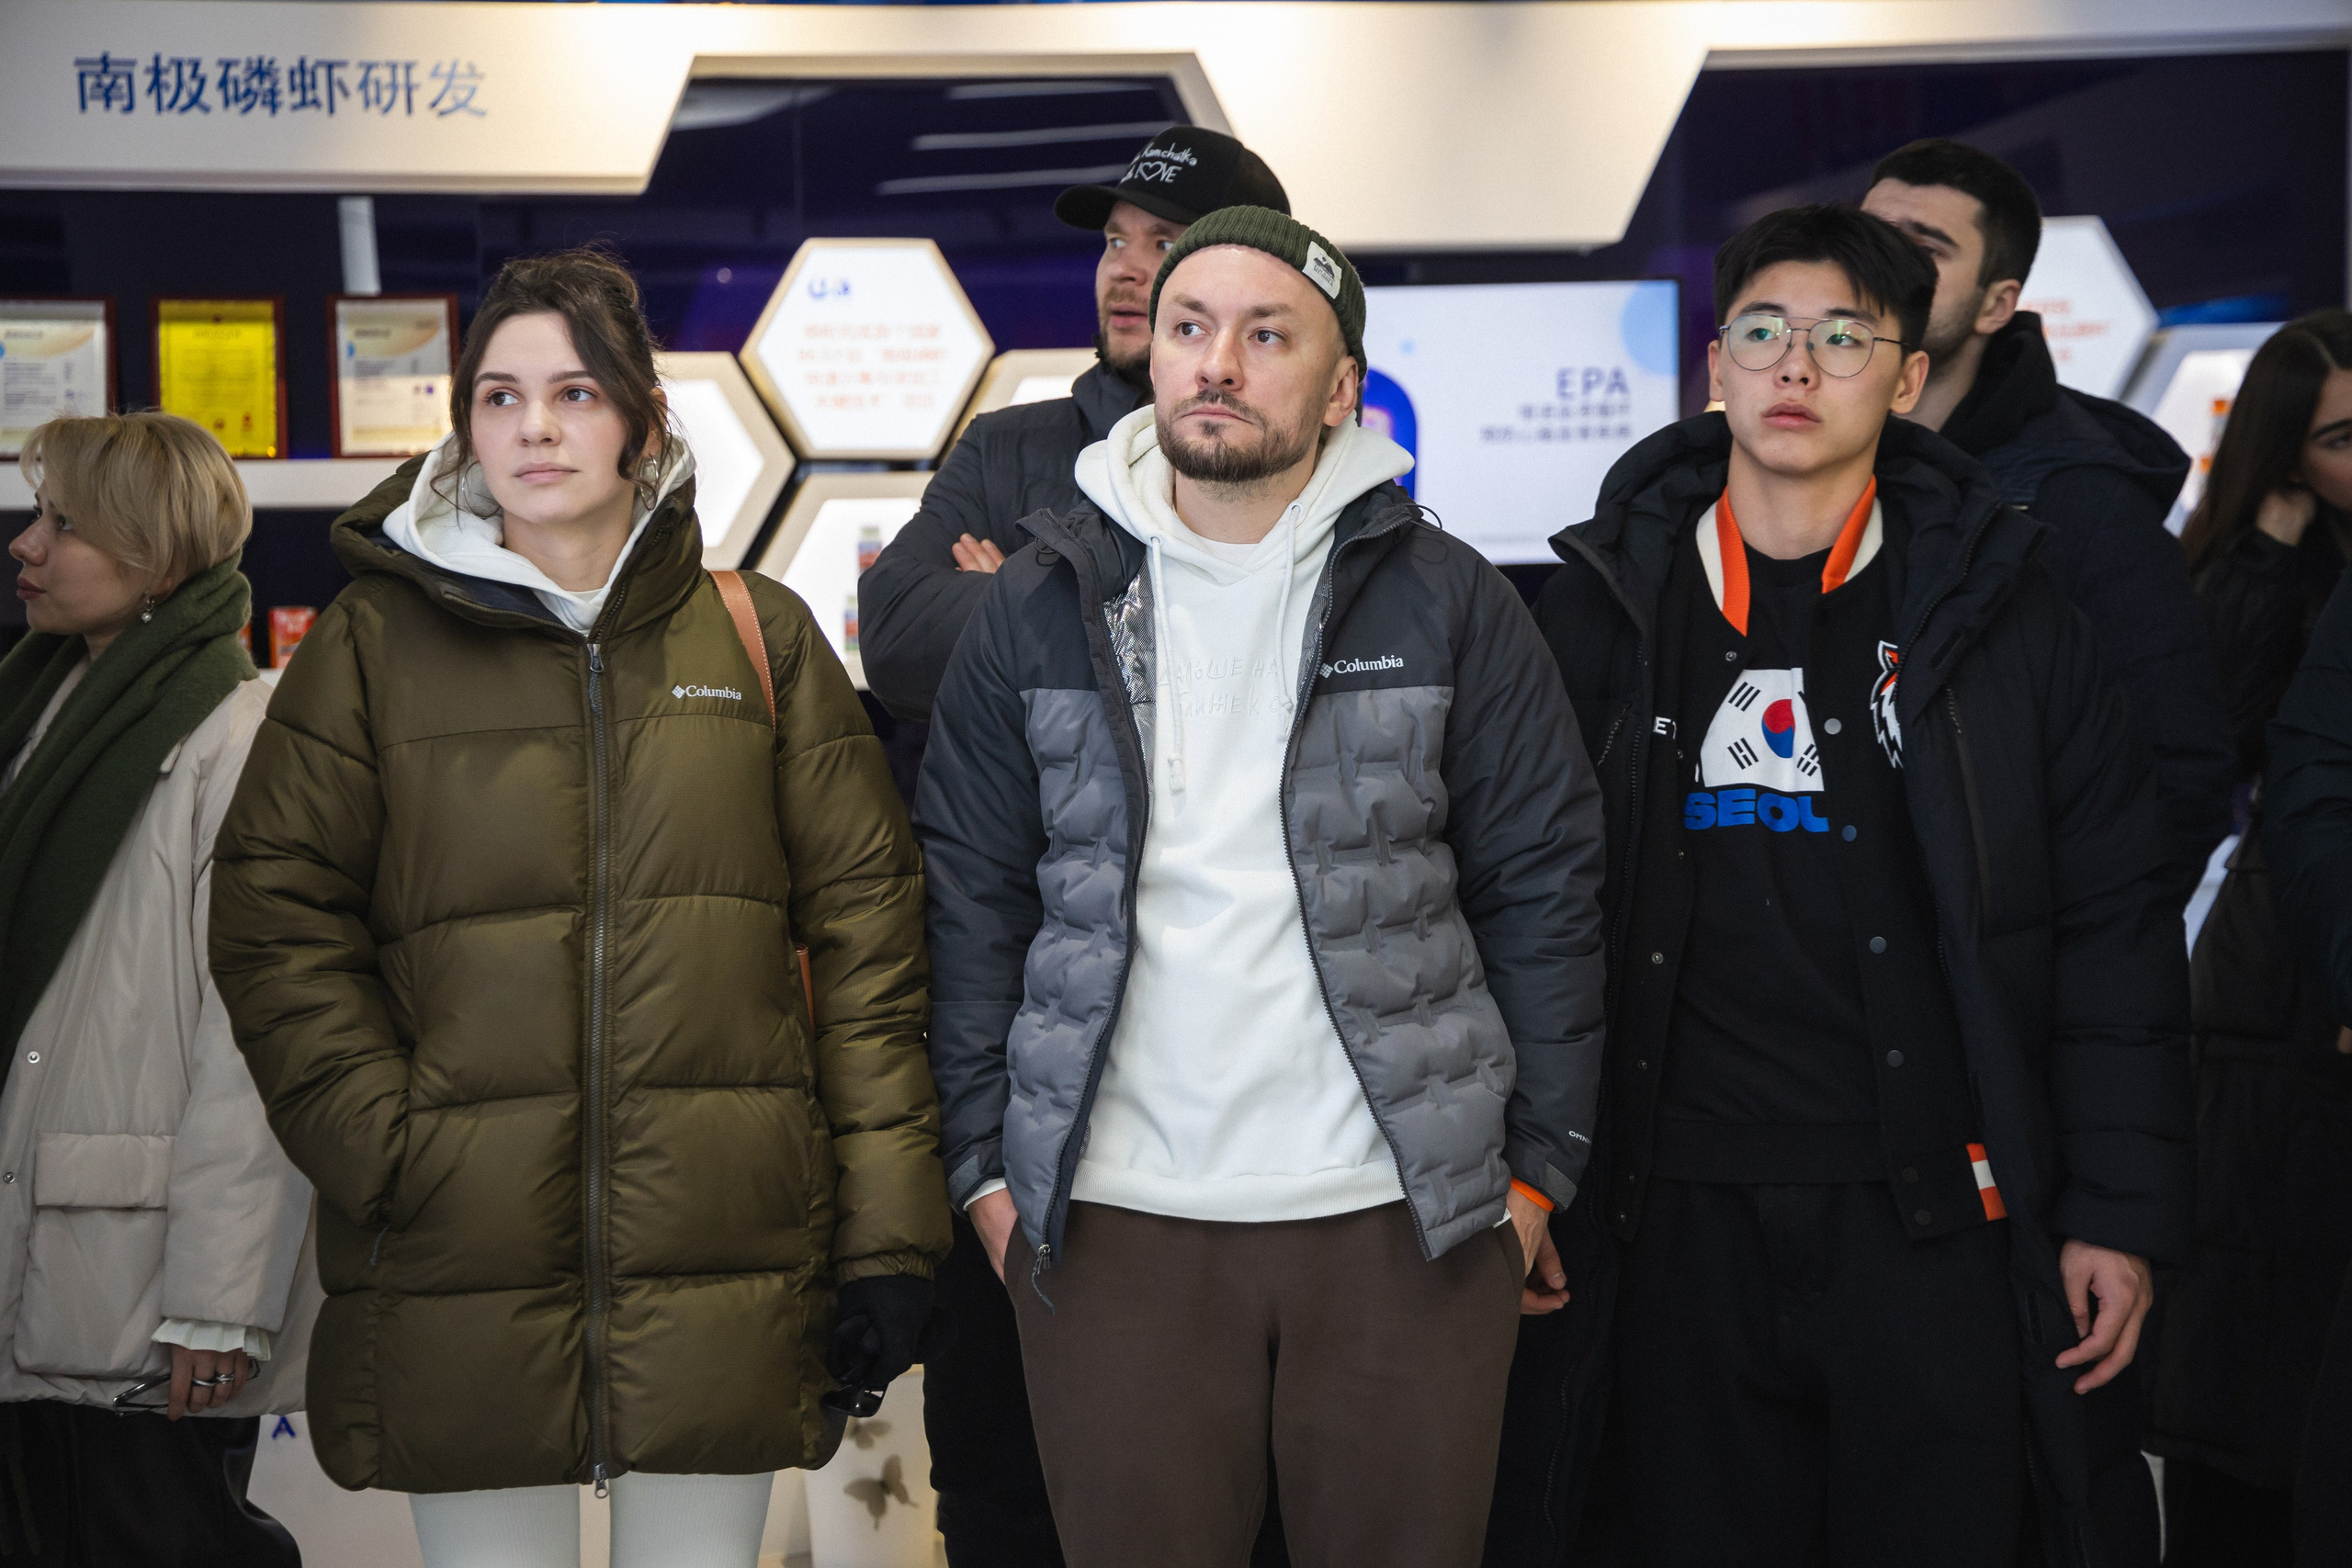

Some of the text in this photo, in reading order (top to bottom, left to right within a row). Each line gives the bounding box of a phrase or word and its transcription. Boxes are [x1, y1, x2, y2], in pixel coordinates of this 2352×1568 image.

[74, 51, 487, 117] 南极磷虾研发
[1557, 367, 1630, 400] EPA
[1334, 655, 1404, 674] Columbia
[685, 685, 741, 700] Columbia
